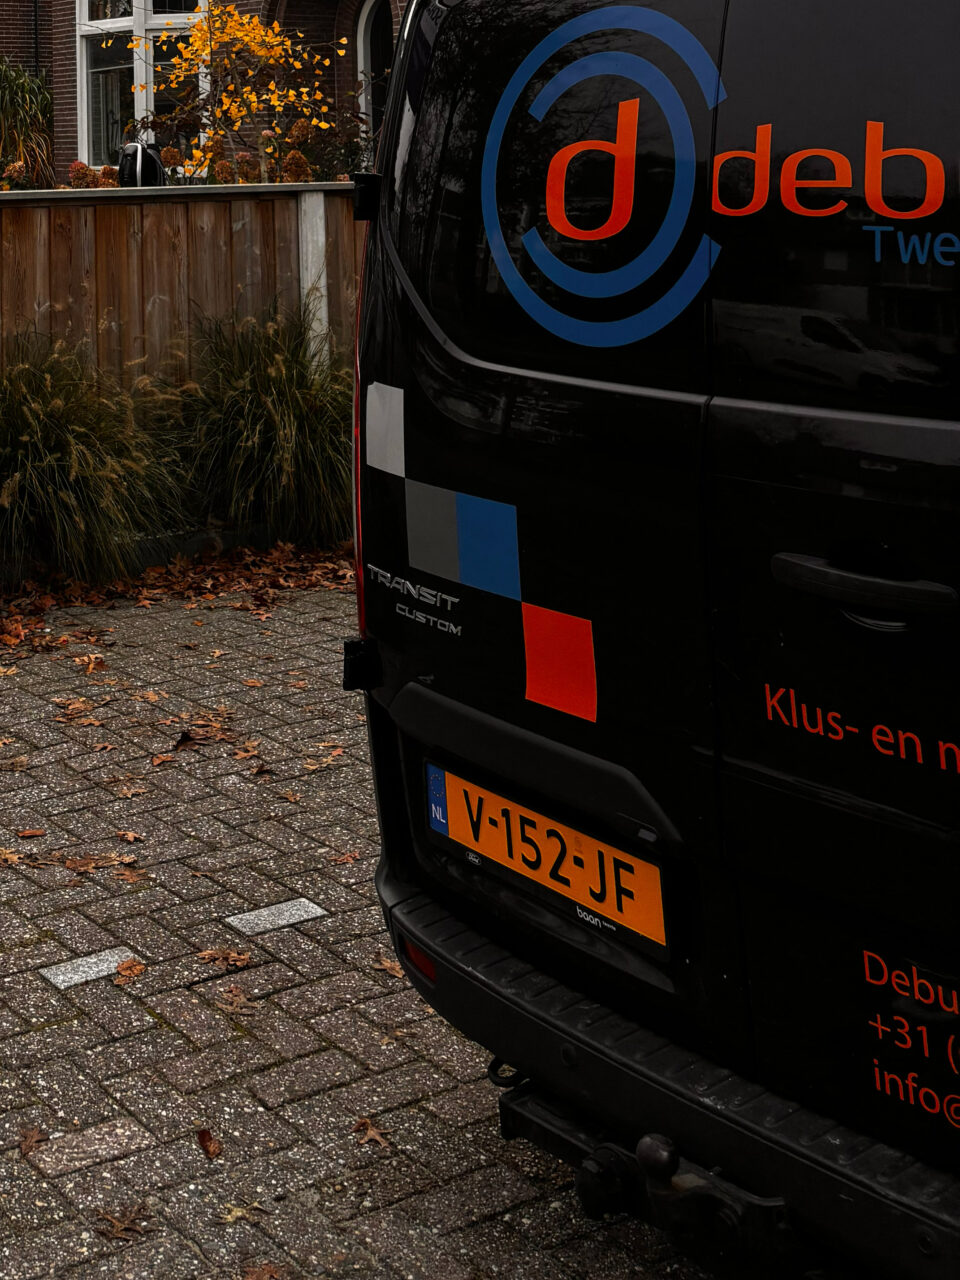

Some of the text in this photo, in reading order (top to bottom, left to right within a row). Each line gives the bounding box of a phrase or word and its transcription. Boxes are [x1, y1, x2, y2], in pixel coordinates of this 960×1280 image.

[545, 97, 640, 241] d
[711, 120, 946, 219] deb
[861, 224, 960, 268] Twe
[367, 563, 460, 611] TRANSIT
[395, 602, 463, 637] CUSTOM
[764, 683, 860, 741] Klus-
[871, 724, 924, 765] en
[431, 803, 447, 824] NL
[463, 789, 635, 914] V-152-JF
[862, 950, 959, 1015] Debu
[867, 1013, 930, 1059] +31
[873, 1058, 960, 1129] info@
